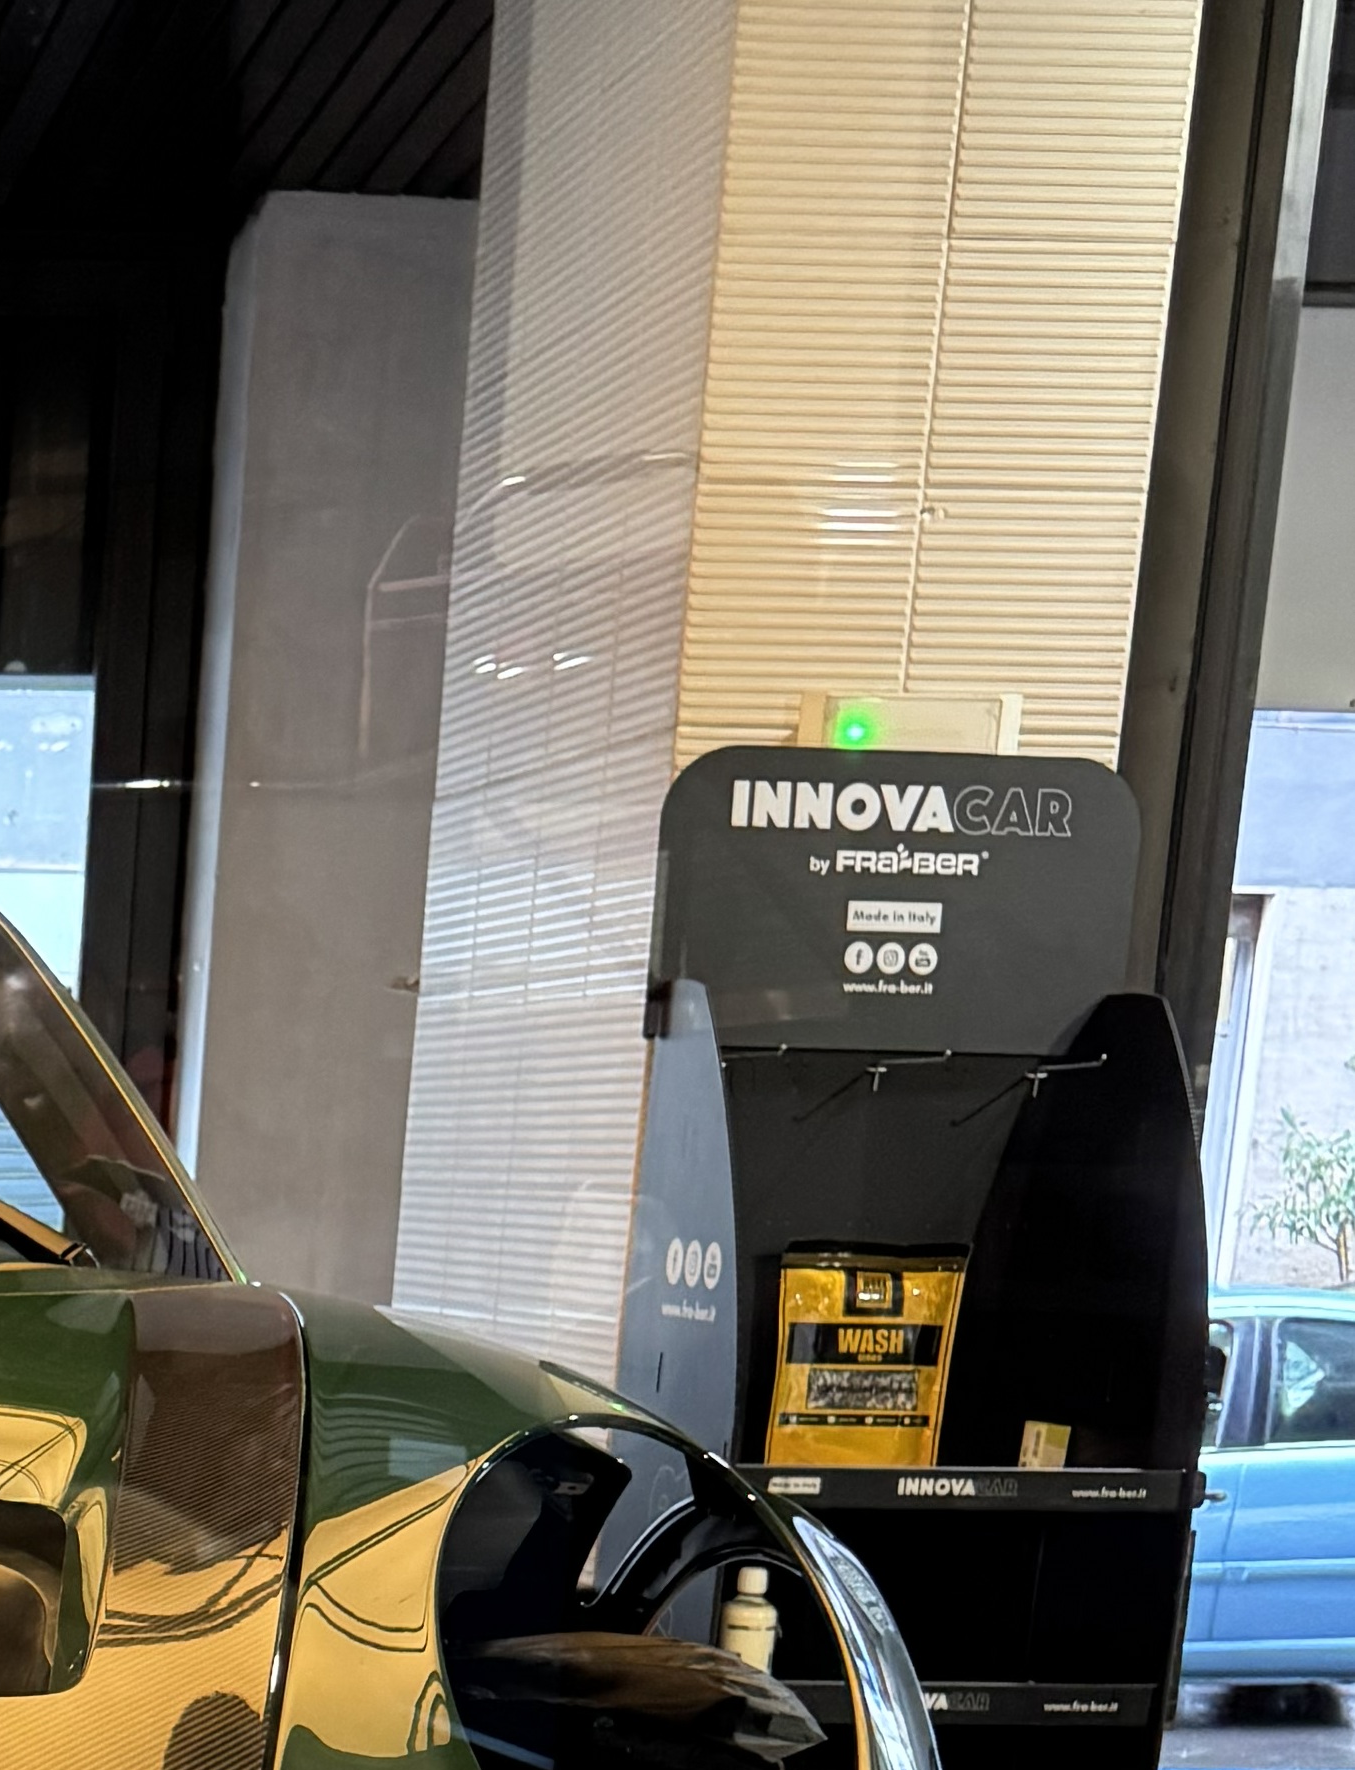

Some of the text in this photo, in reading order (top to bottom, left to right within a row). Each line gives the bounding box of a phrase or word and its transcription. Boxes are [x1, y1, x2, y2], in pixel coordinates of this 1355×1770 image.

[731, 779, 1072, 837] INNOVACAR
[809, 855, 830, 876] by
[852, 910, 937, 926] Made in Italy
[842, 979, 933, 995] www.fra-ber.it
[838, 1328, 904, 1354] WASH
[897, 1477, 1018, 1496] INNOVACAR
[1071, 1486, 1147, 1499] www.fra-ber.it
